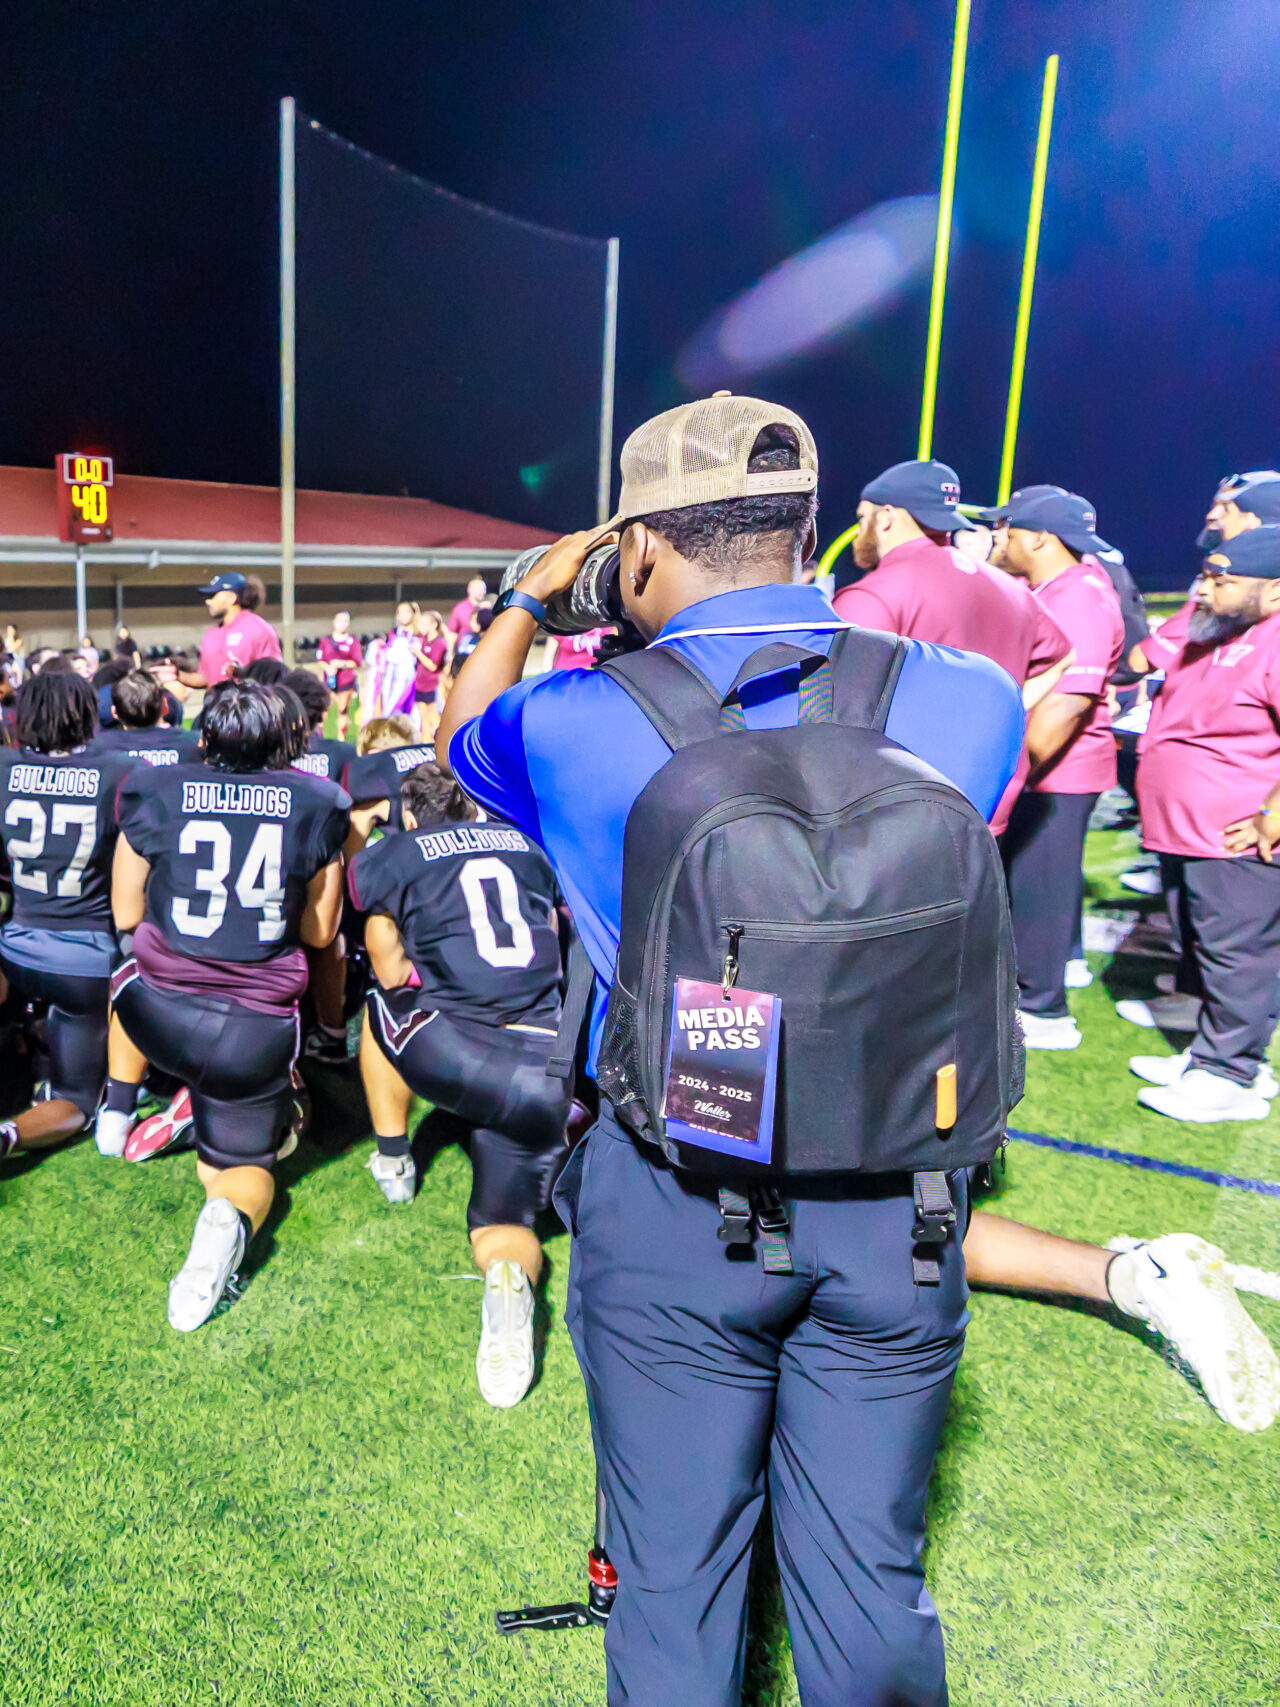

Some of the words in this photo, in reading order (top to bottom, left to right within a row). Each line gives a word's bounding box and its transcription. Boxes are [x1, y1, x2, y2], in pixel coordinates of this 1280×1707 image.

[72, 484, 108, 524] 40
[7, 764, 101, 798] BULLDOGS
[182, 782, 292, 818] BULLDOGS
[4, 798, 98, 897] 27
[415, 828, 530, 862] BULLDOGS
[171, 819, 287, 943] 34
[459, 857, 536, 968] 0
[677, 1005, 766, 1030] MEDIA
[687, 1028, 761, 1051] PASS
[678, 1075, 709, 1092] 2024
[719, 1085, 752, 1103] 2025
[694, 1099, 733, 1120] Waller
